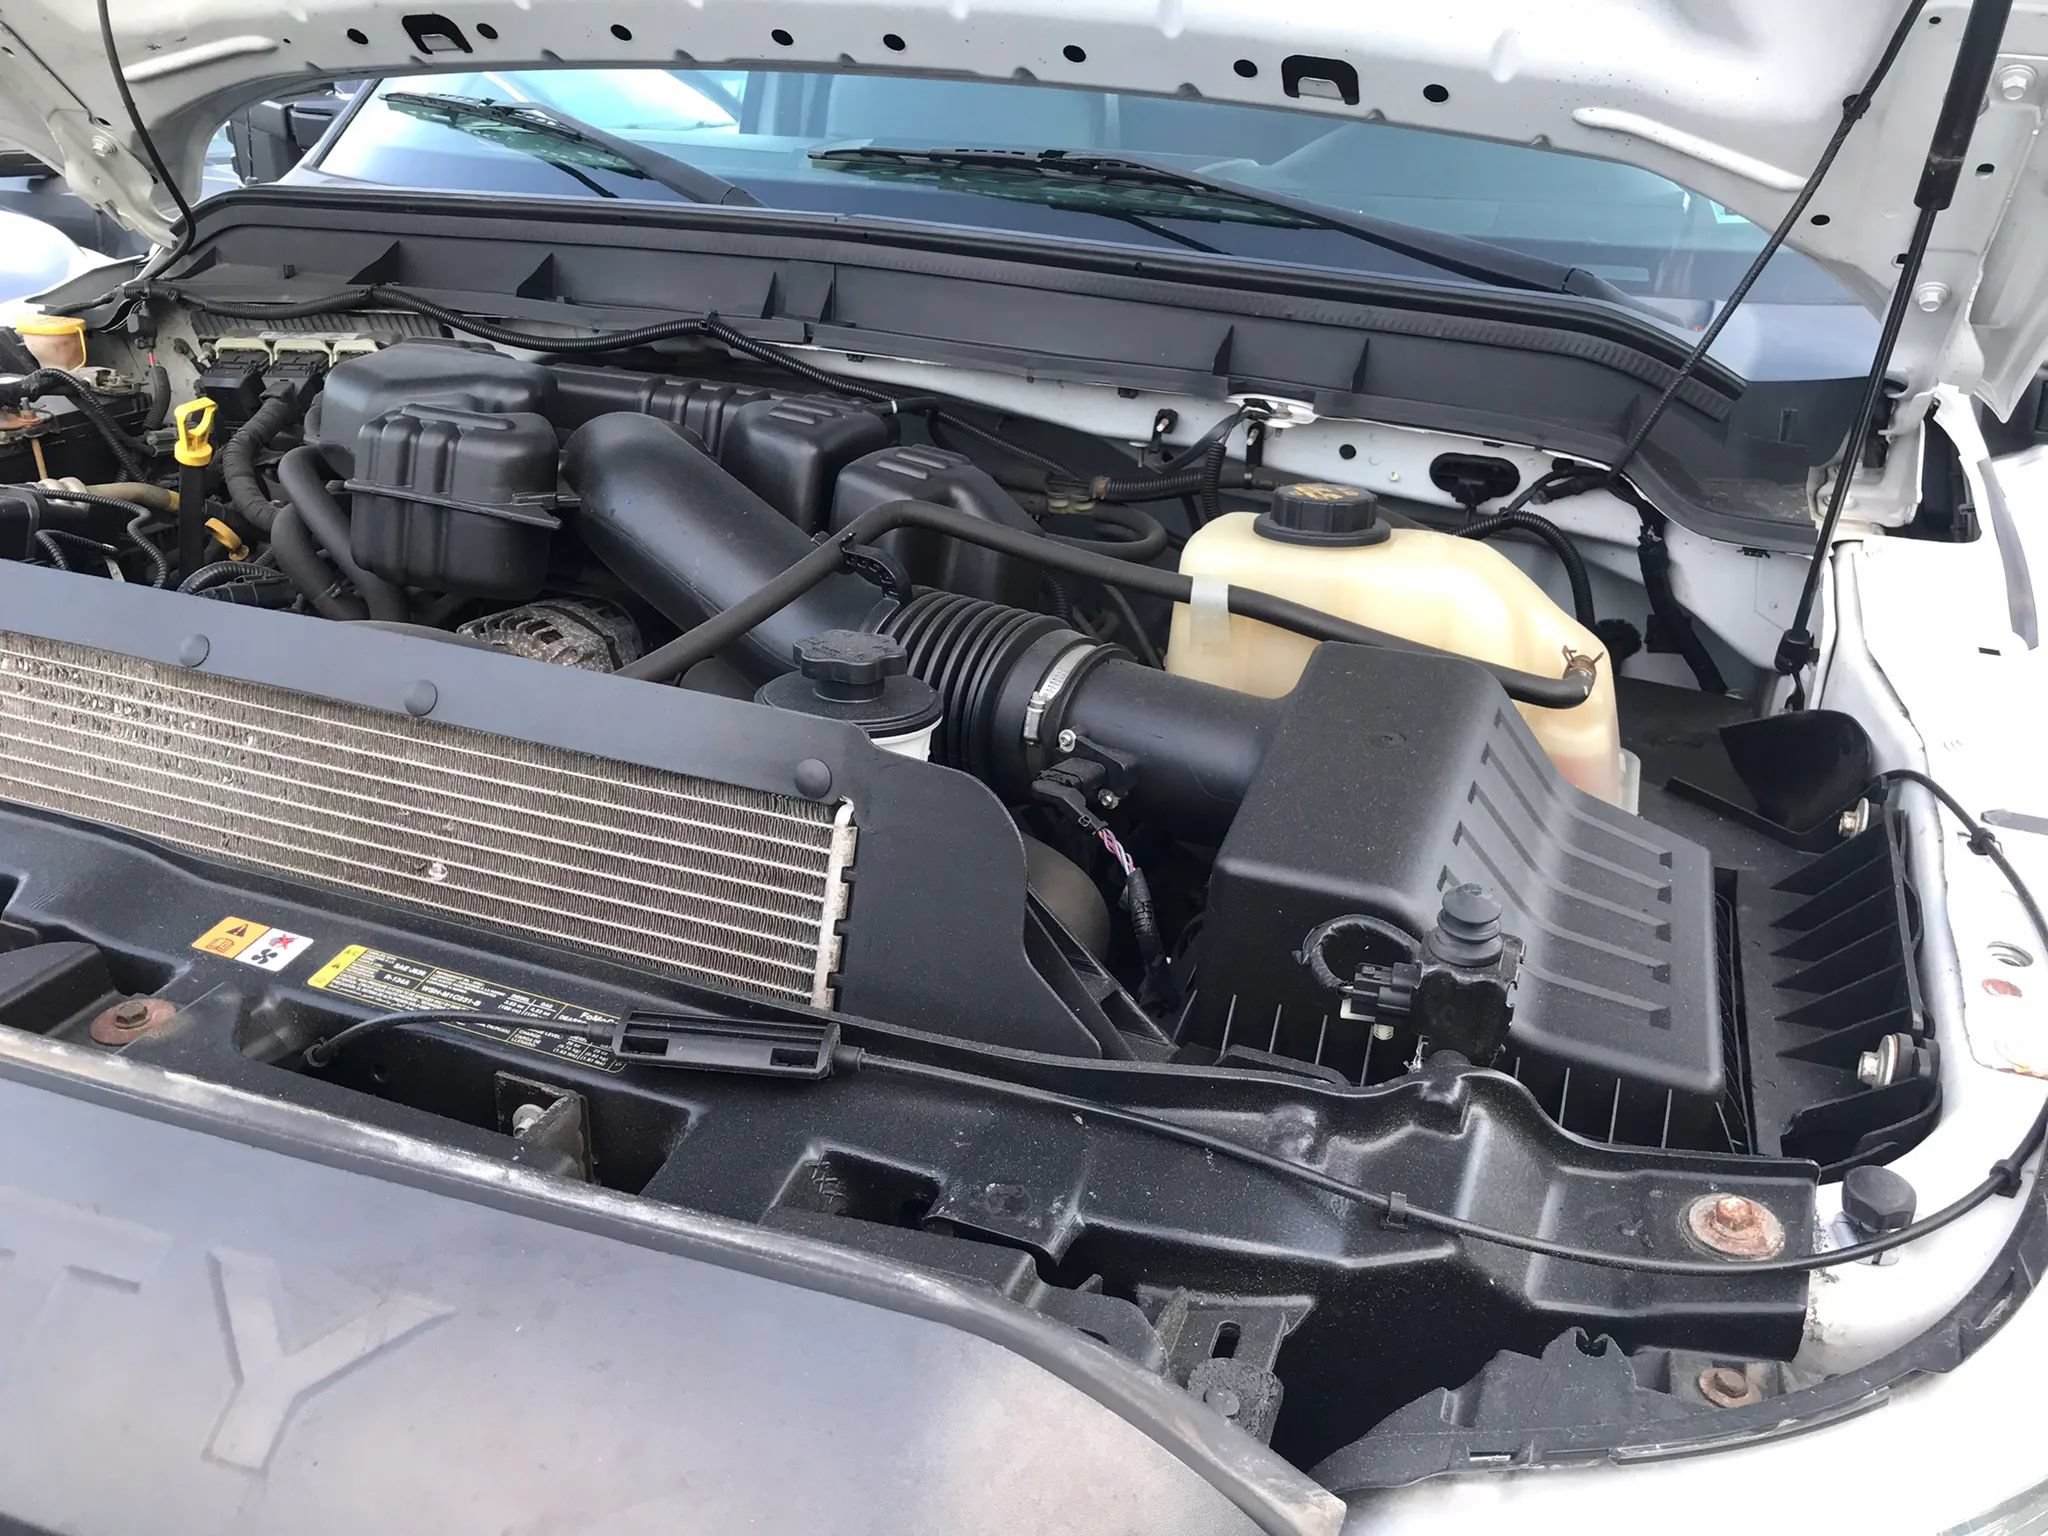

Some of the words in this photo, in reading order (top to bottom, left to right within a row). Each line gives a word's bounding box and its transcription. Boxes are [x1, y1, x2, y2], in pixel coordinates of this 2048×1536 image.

[393, 963, 410, 972] SAE
[383, 973, 411, 986] R-134A
[421, 985, 482, 1007] WSH-M1C231-B
